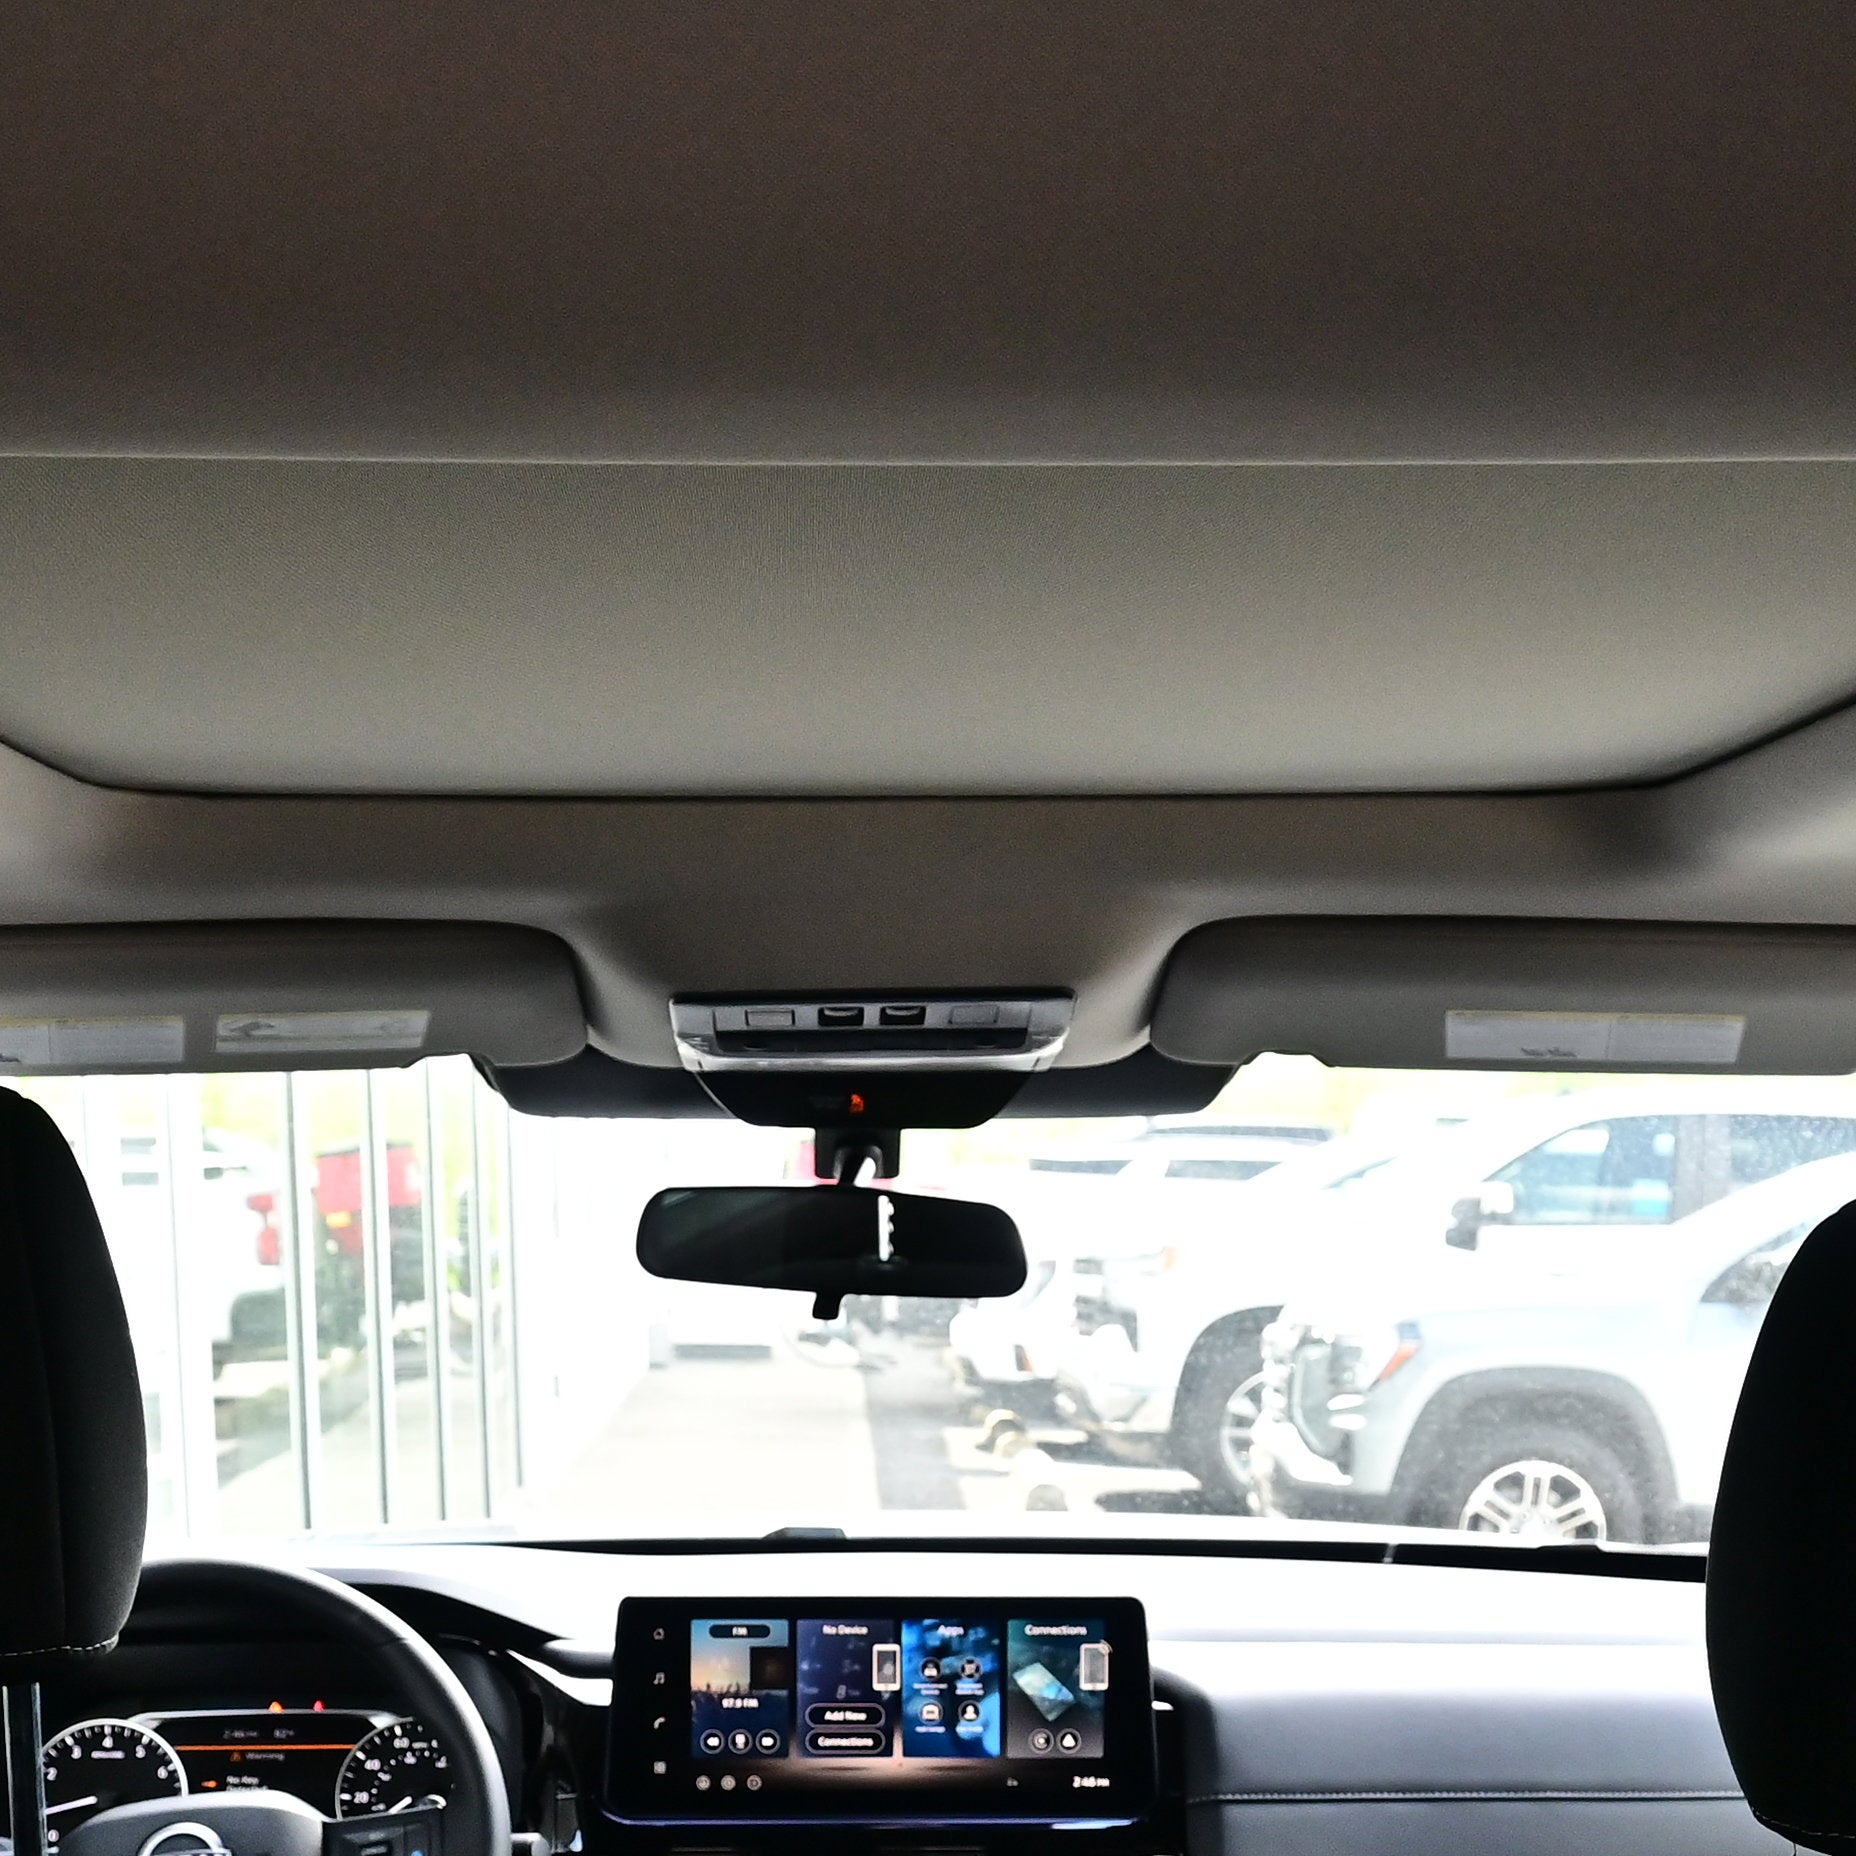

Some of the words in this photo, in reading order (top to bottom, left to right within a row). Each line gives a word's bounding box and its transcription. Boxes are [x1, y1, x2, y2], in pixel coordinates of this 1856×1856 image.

[1024, 1624, 1087, 1636] Connections
[102, 1735, 114, 1749] 4
[817, 1735, 874, 1747] Connections
[71, 1744, 82, 1760] 3
[135, 1744, 146, 1759] 5
[46, 1766, 58, 1781] 2
[157, 1765, 169, 1780] 6
[353, 1791, 370, 1804] 20
